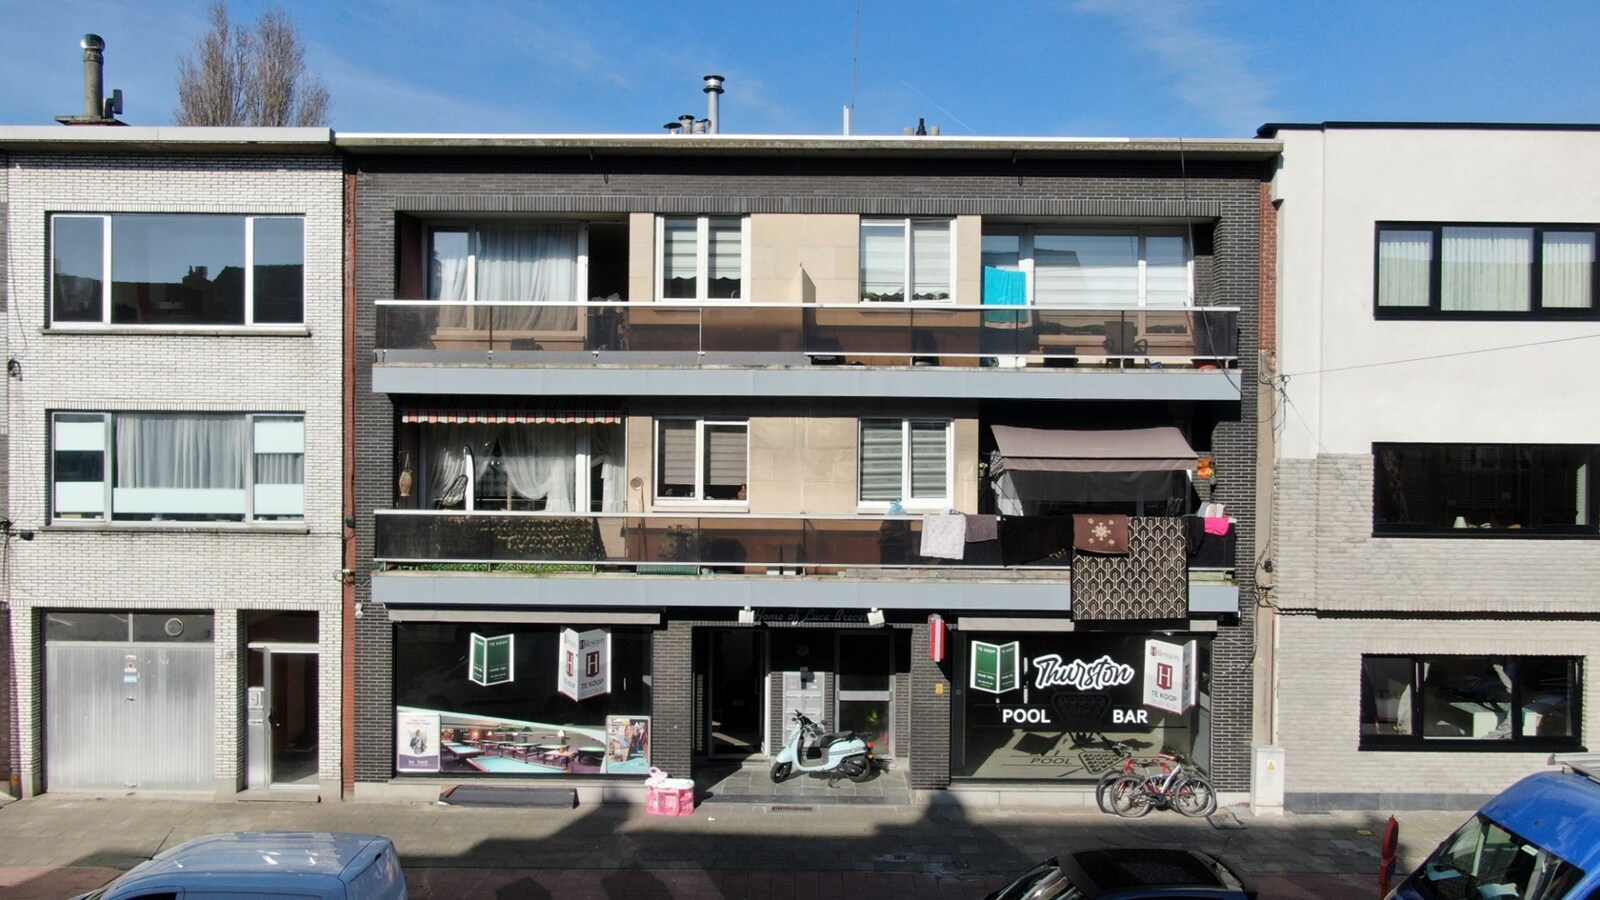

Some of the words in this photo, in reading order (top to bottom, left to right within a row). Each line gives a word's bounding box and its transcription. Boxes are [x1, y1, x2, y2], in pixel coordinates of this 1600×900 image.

[755, 608, 785, 621] Home
[787, 609, 801, 624] of
[801, 608, 830, 623] Luca
[1033, 654, 1135, 690] Thurston
[1151, 690, 1159, 698] TE
[1160, 693, 1177, 702] KOOP
[1002, 708, 1051, 723] POOL
[1113, 709, 1148, 723] BAR
